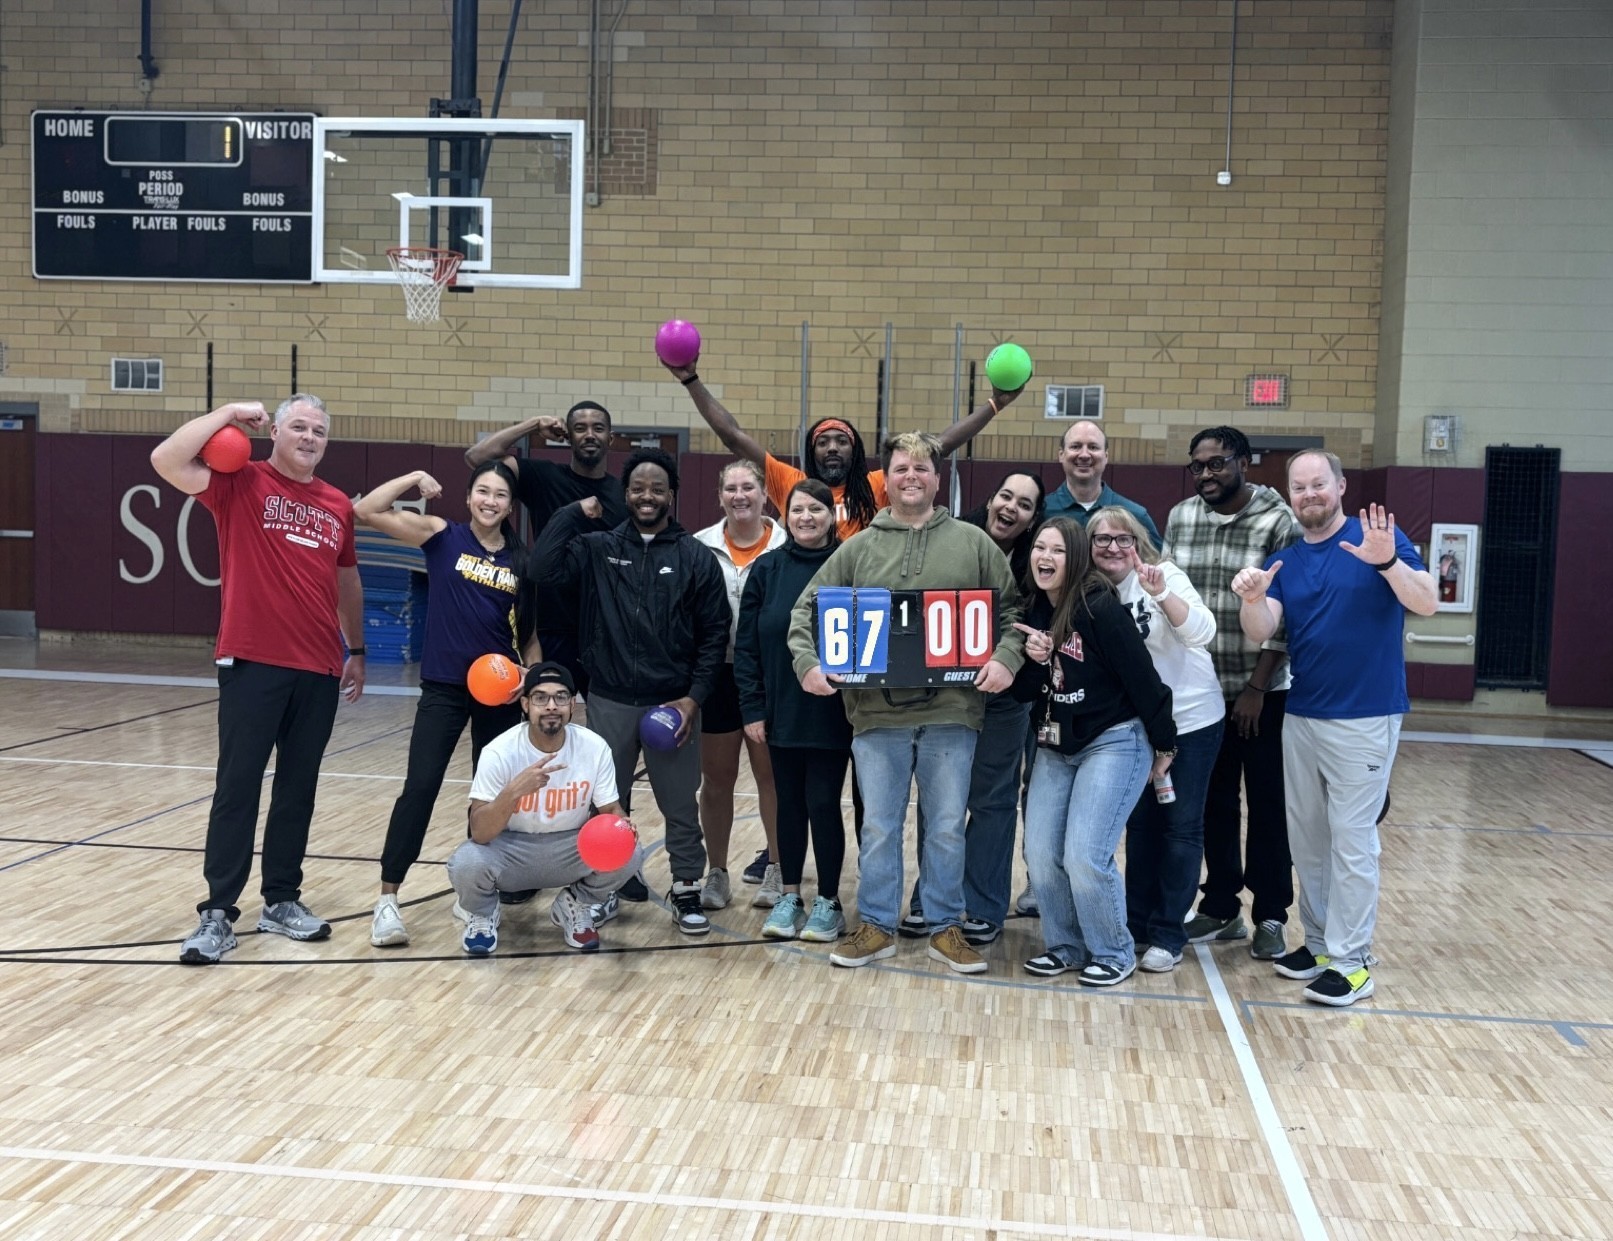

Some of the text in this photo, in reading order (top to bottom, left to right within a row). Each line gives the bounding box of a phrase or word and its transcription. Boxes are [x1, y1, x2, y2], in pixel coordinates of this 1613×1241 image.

[44, 119, 94, 137] HOME
[245, 121, 312, 140] VISITOR
[149, 170, 174, 180] POSS
[138, 182, 184, 196] PERIOD
[63, 190, 104, 204] BONUS
[242, 192, 285, 206] BONUS
[57, 215, 95, 229] FOULS
[132, 216, 226, 231] PLAYER FOULS
[252, 218, 292, 232] FOULS
[263, 495, 340, 541] SCOTT
[263, 523, 301, 532] MIDDLE
[305, 529, 338, 550] SCHOOL
[455, 557, 496, 581] GOLDEN
[900, 600, 908, 627] 1
[943, 671, 976, 681] GUEST
[545, 780, 590, 818] grit?
